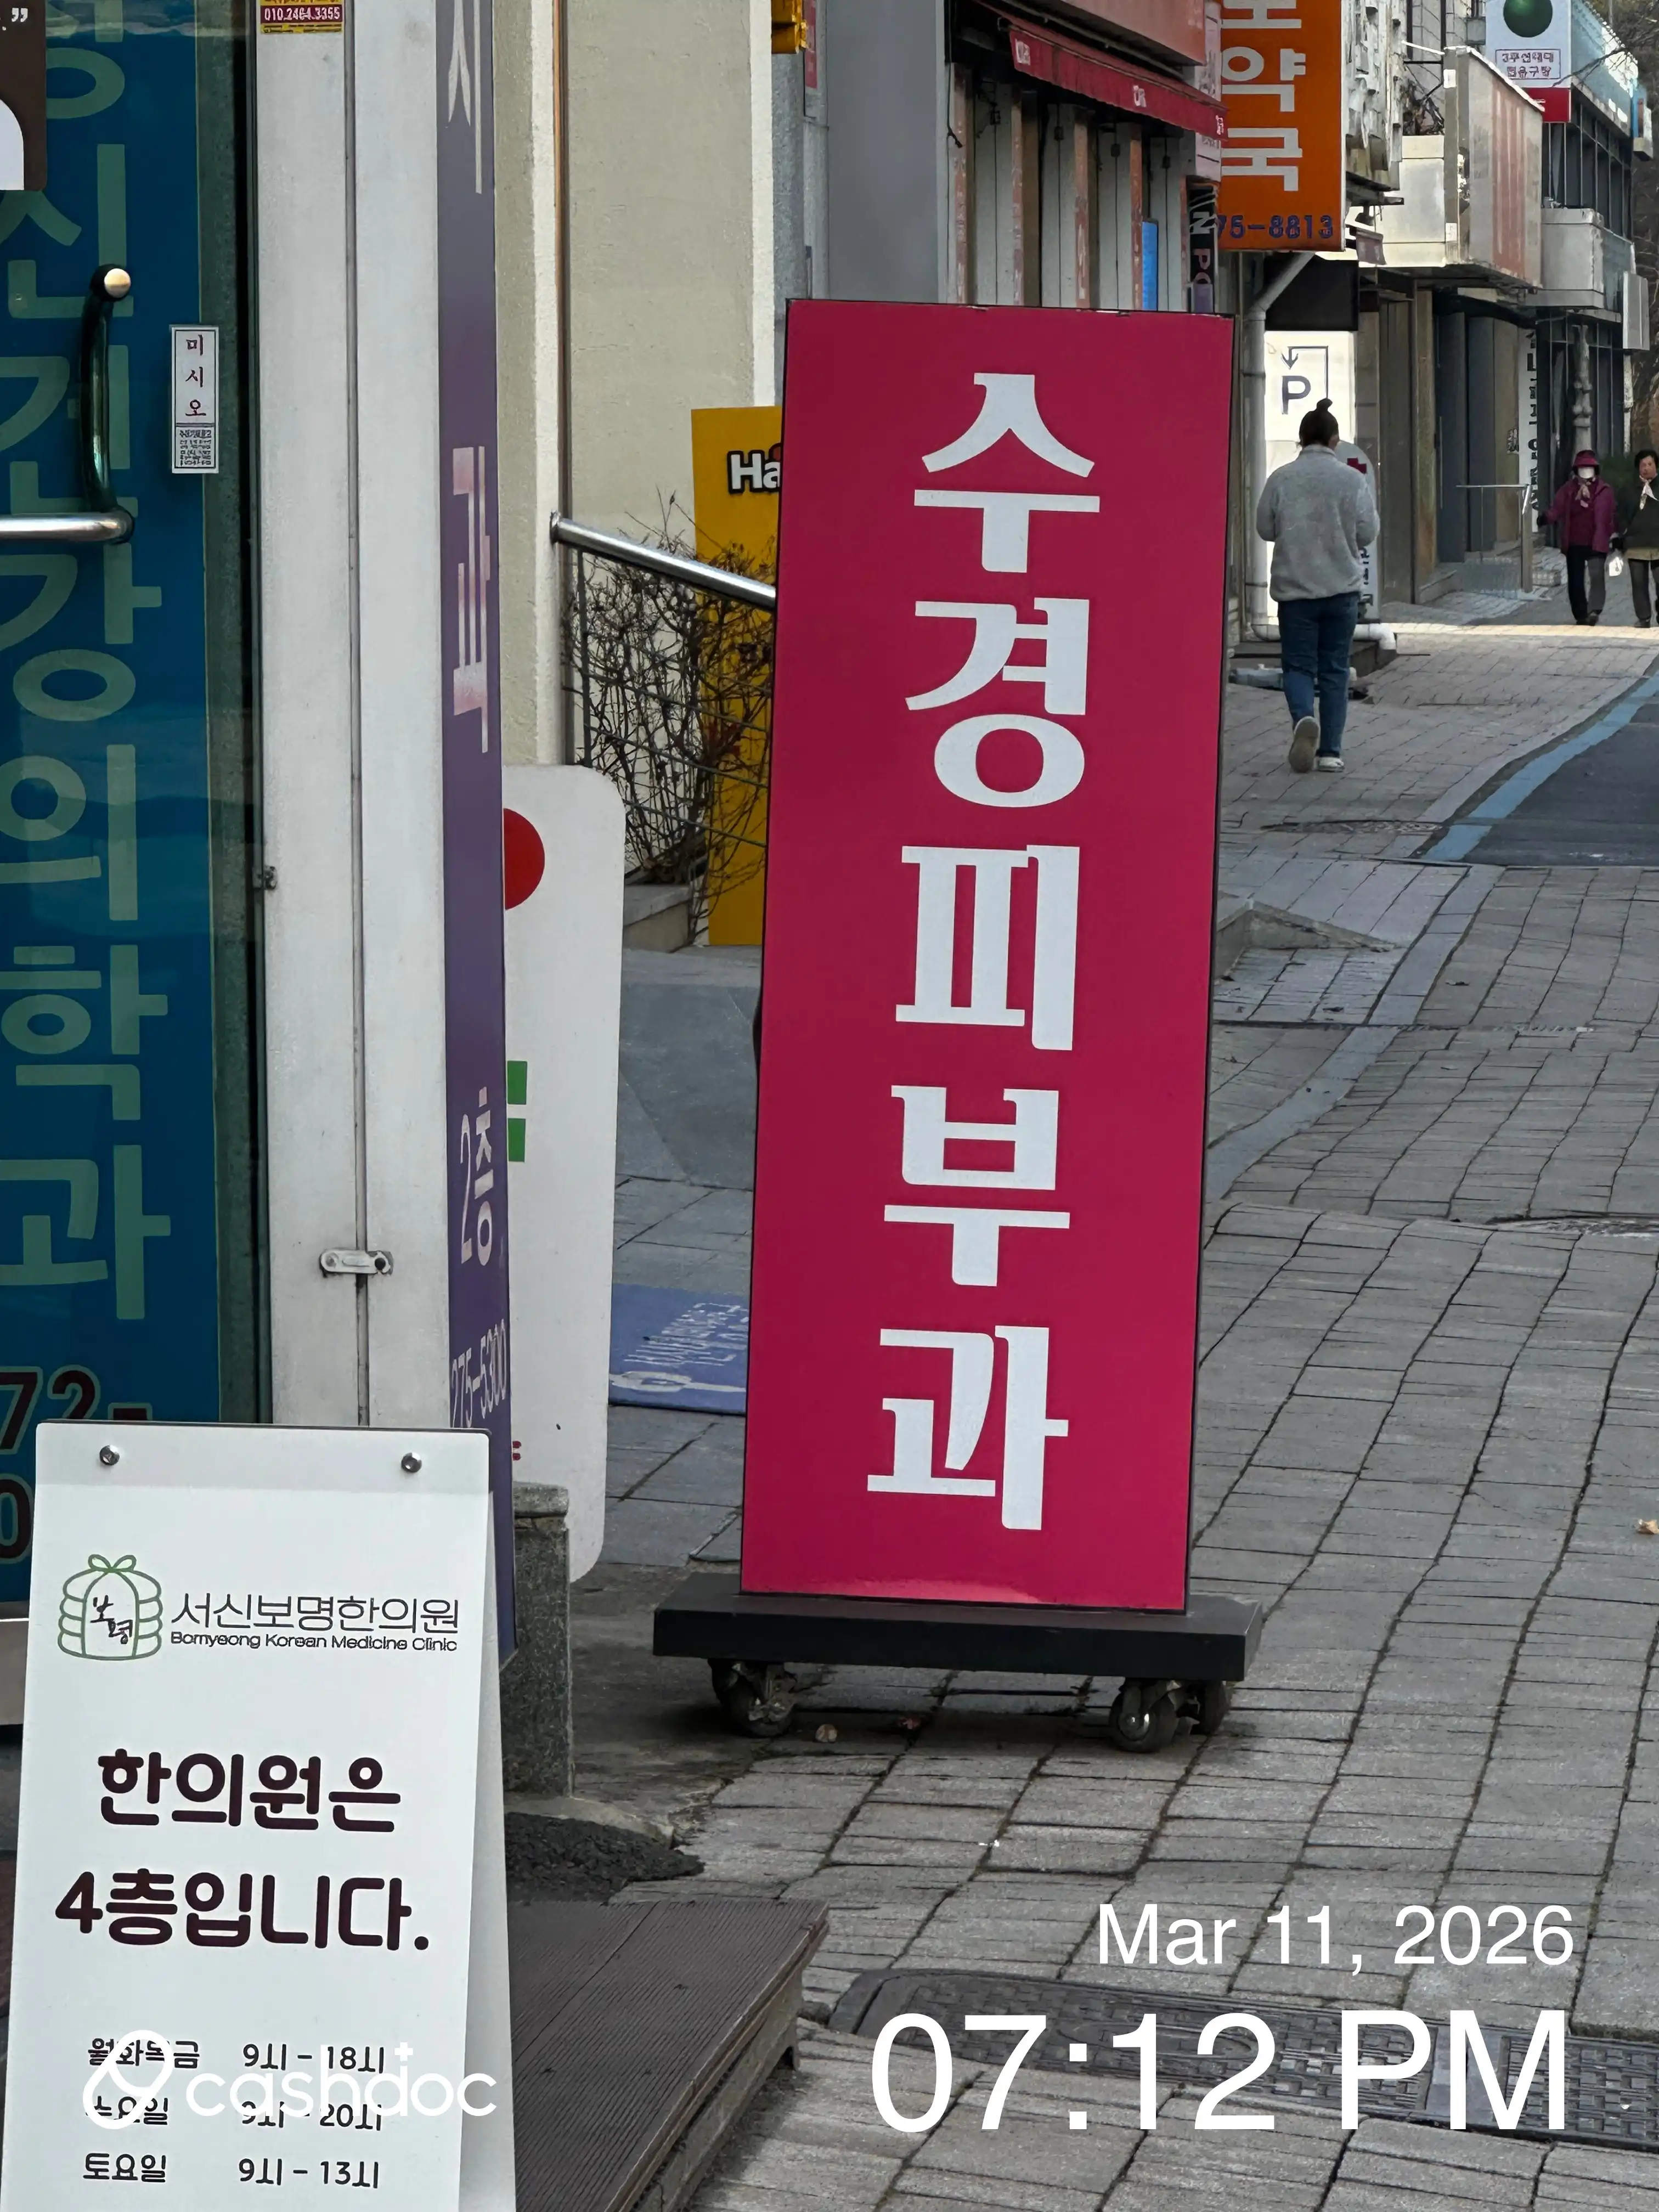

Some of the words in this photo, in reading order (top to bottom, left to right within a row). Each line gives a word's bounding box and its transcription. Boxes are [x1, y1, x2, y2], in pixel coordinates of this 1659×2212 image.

[185, 334, 207, 417] 미시오
[1282, 376, 1312, 415] P
[867, 373, 1099, 1530] 수경피부과
[460, 1086, 494, 1266] 2층
[171, 1593, 458, 1633] 서신보명한의원
[171, 1632, 261, 1649] Bomyeong
[266, 1634, 328, 1648] Korean
[331, 1635, 408, 1650] Medicine
[413, 1637, 457, 1651] Clinic
[98, 1748, 401, 1832] 한의원은
[55, 1868, 429, 1951] 4층입니다.
[243, 2043, 286, 2070] 9시
[328, 2046, 384, 2074] 18시
[83, 2153, 166, 2183] 토요일
[239, 2158, 283, 2186] 9시
[320, 2161, 379, 2189] 13시
